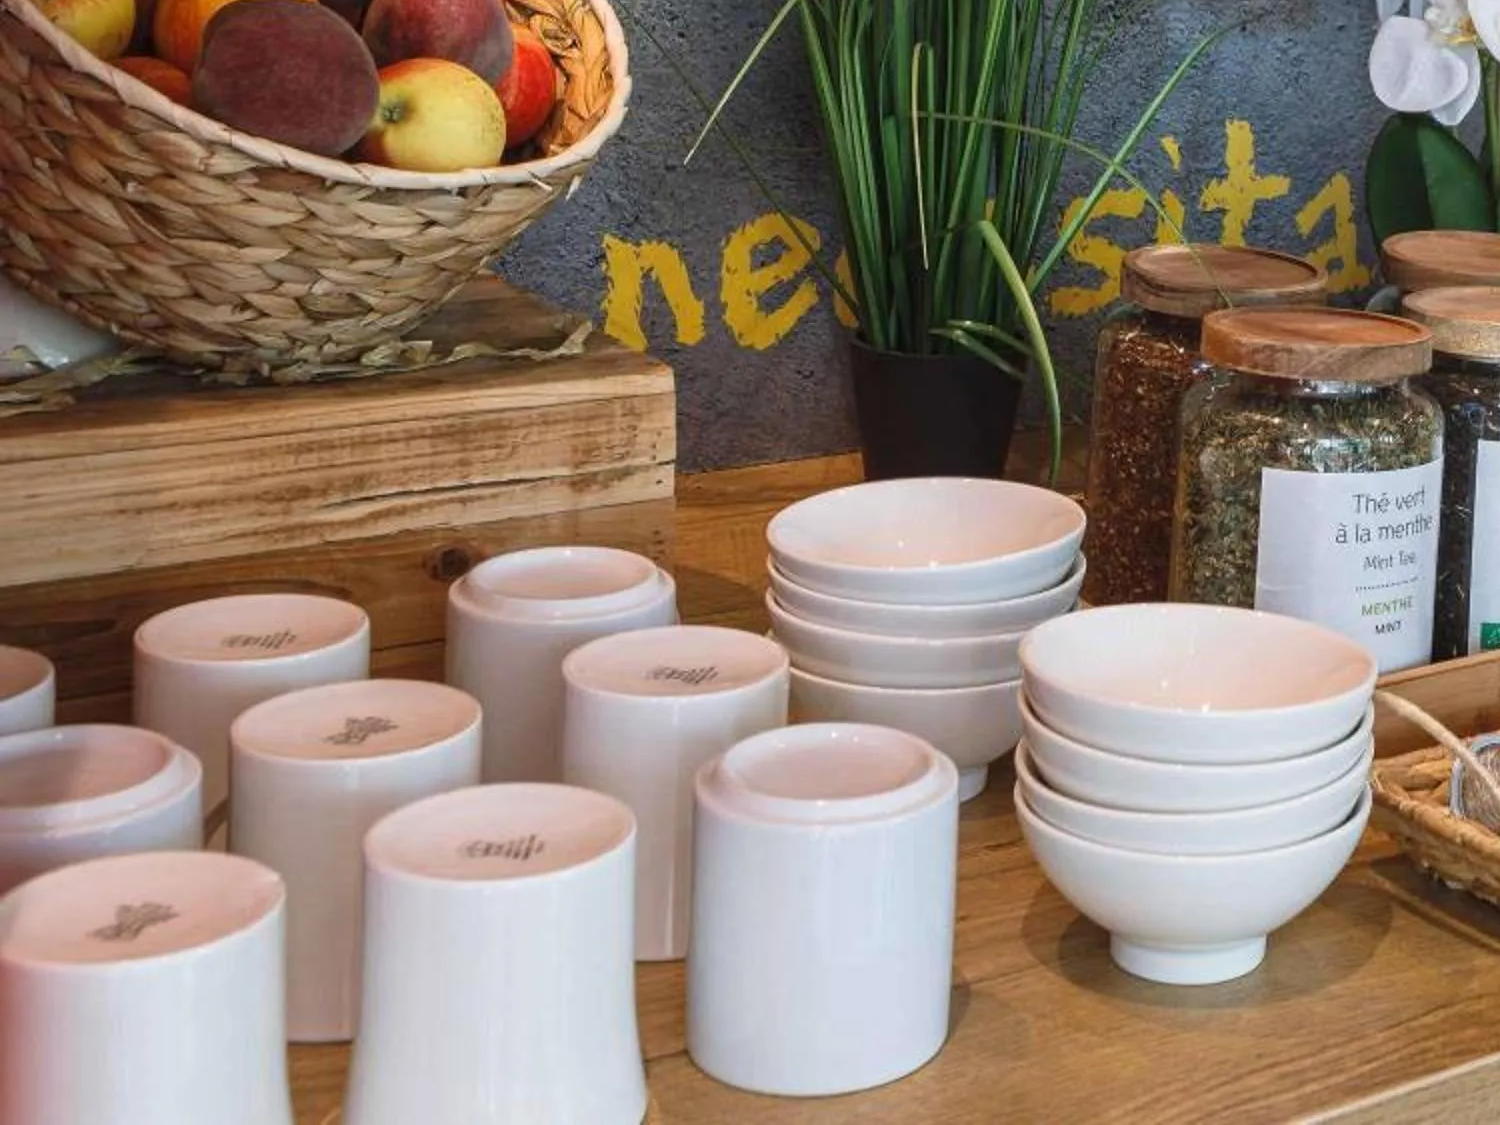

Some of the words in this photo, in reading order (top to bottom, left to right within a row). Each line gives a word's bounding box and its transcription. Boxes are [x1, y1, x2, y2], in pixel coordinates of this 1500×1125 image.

[1352, 491, 1391, 515] Thé
[1394, 486, 1427, 512] vert
[1335, 523, 1348, 544] à
[1354, 522, 1373, 544] la
[1377, 513, 1434, 540] menthe
[1363, 555, 1395, 571] Mint
[1360, 597, 1415, 617] MENTHE
